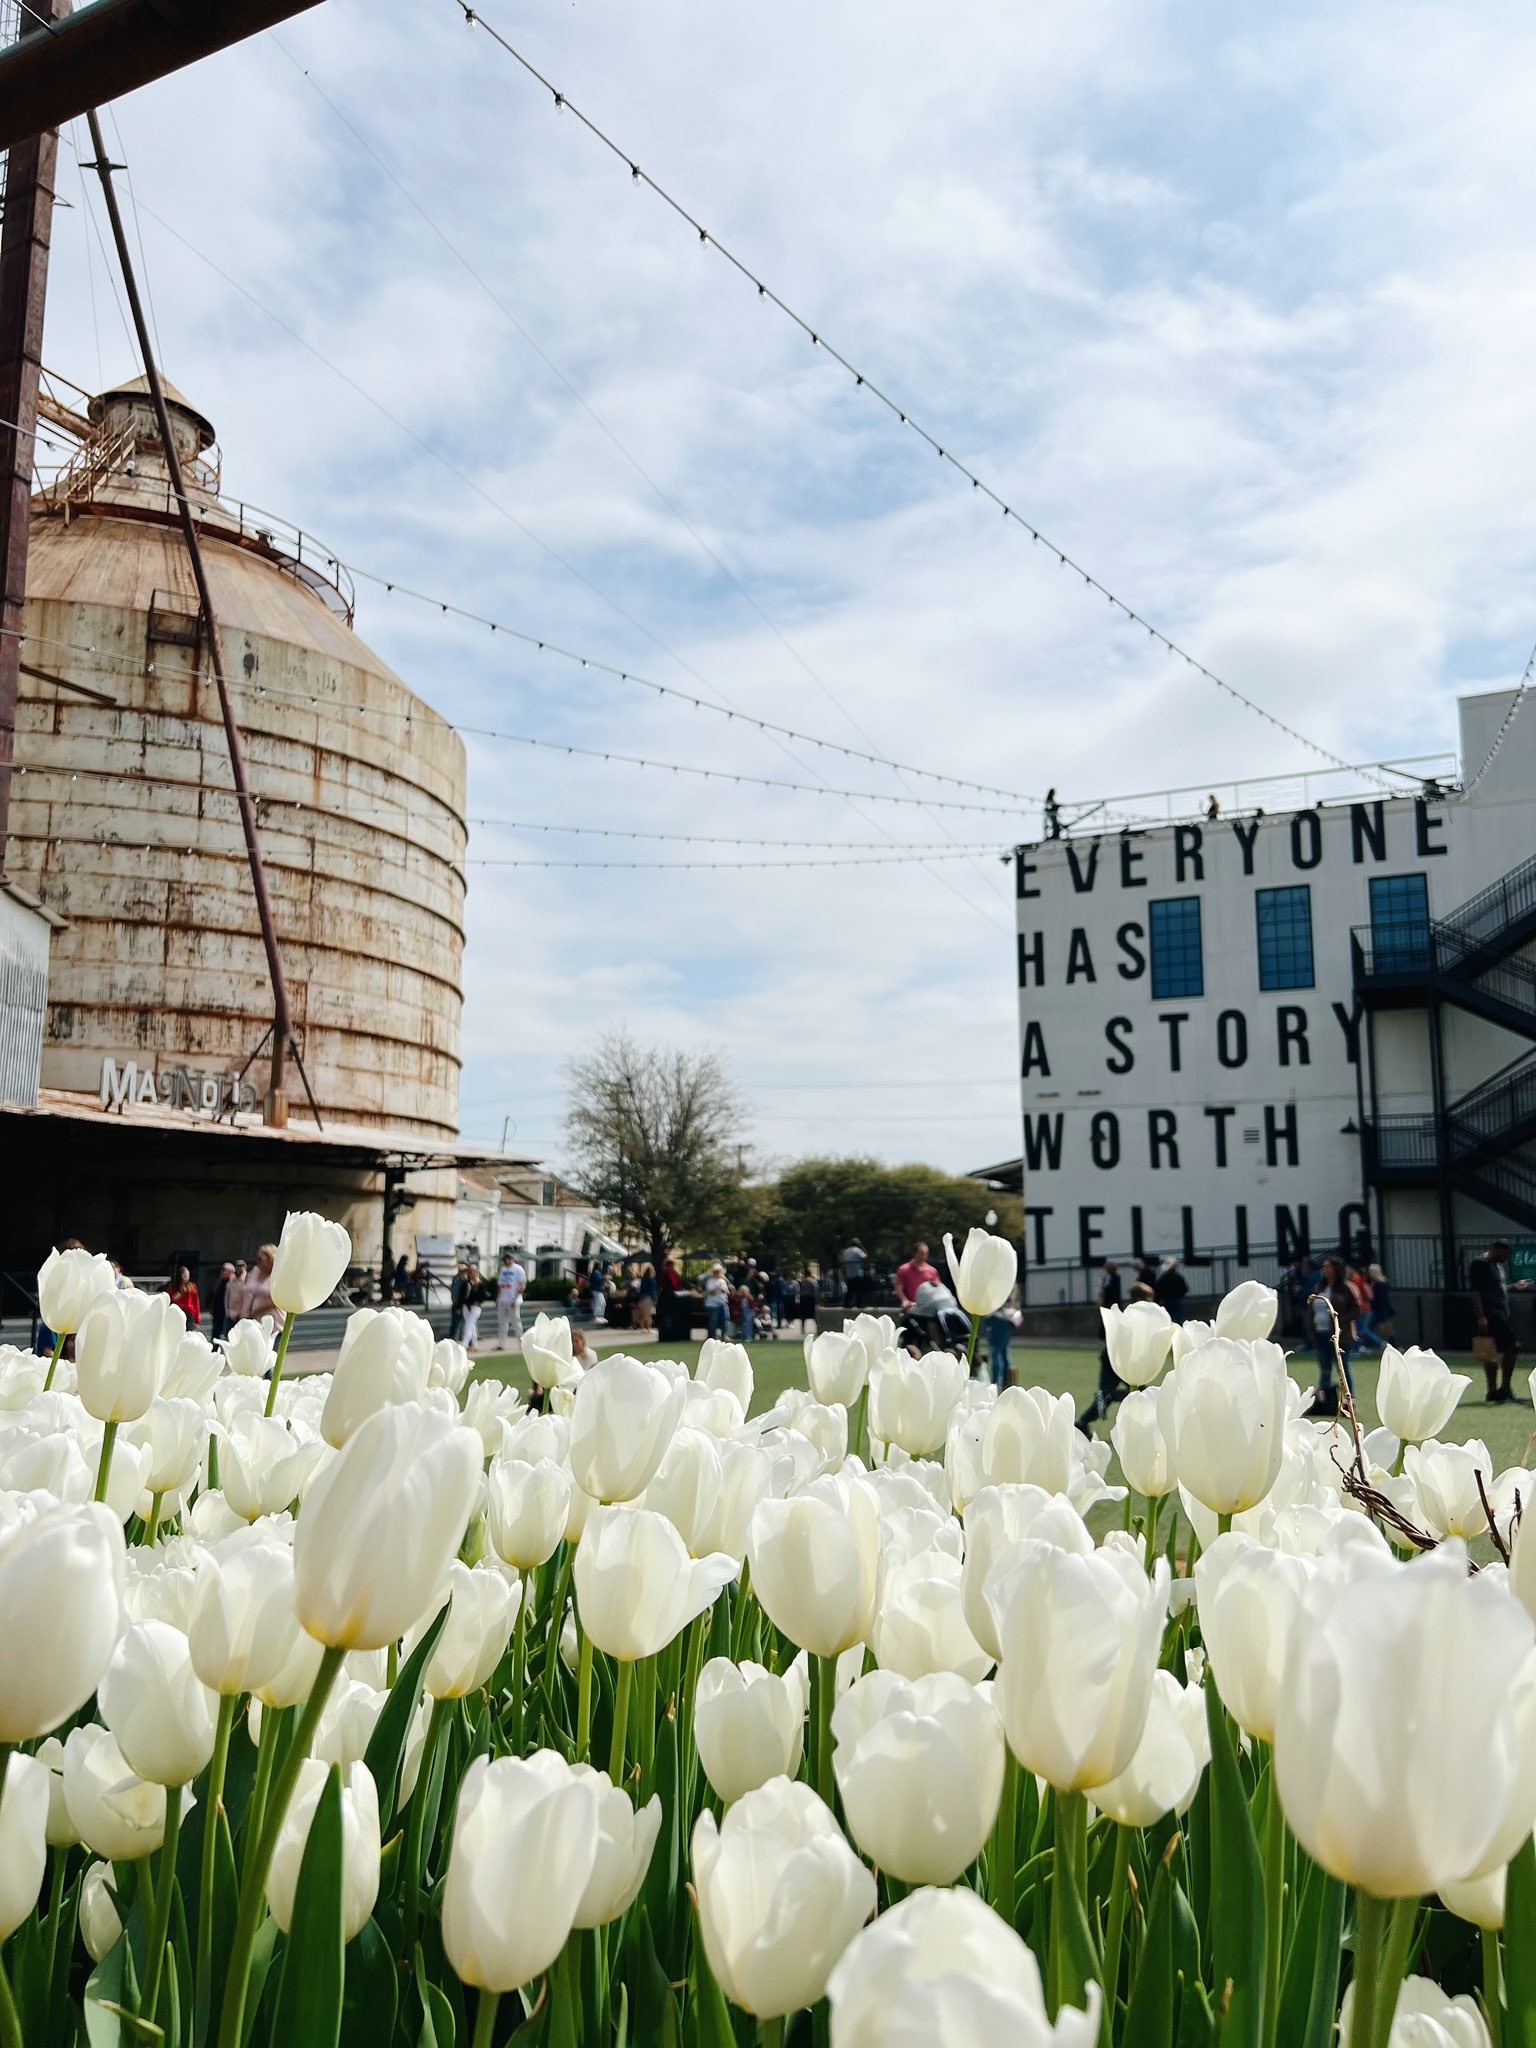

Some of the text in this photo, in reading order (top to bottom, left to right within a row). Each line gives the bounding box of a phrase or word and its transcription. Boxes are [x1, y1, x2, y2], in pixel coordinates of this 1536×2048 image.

[1016, 797, 1448, 898] EVERYONE
[1017, 922, 1146, 987] HAS
[1021, 1002, 1363, 1077] A STORY
[1023, 1105, 1300, 1171] WORTH
[1024, 1202, 1371, 1267] TELLING
